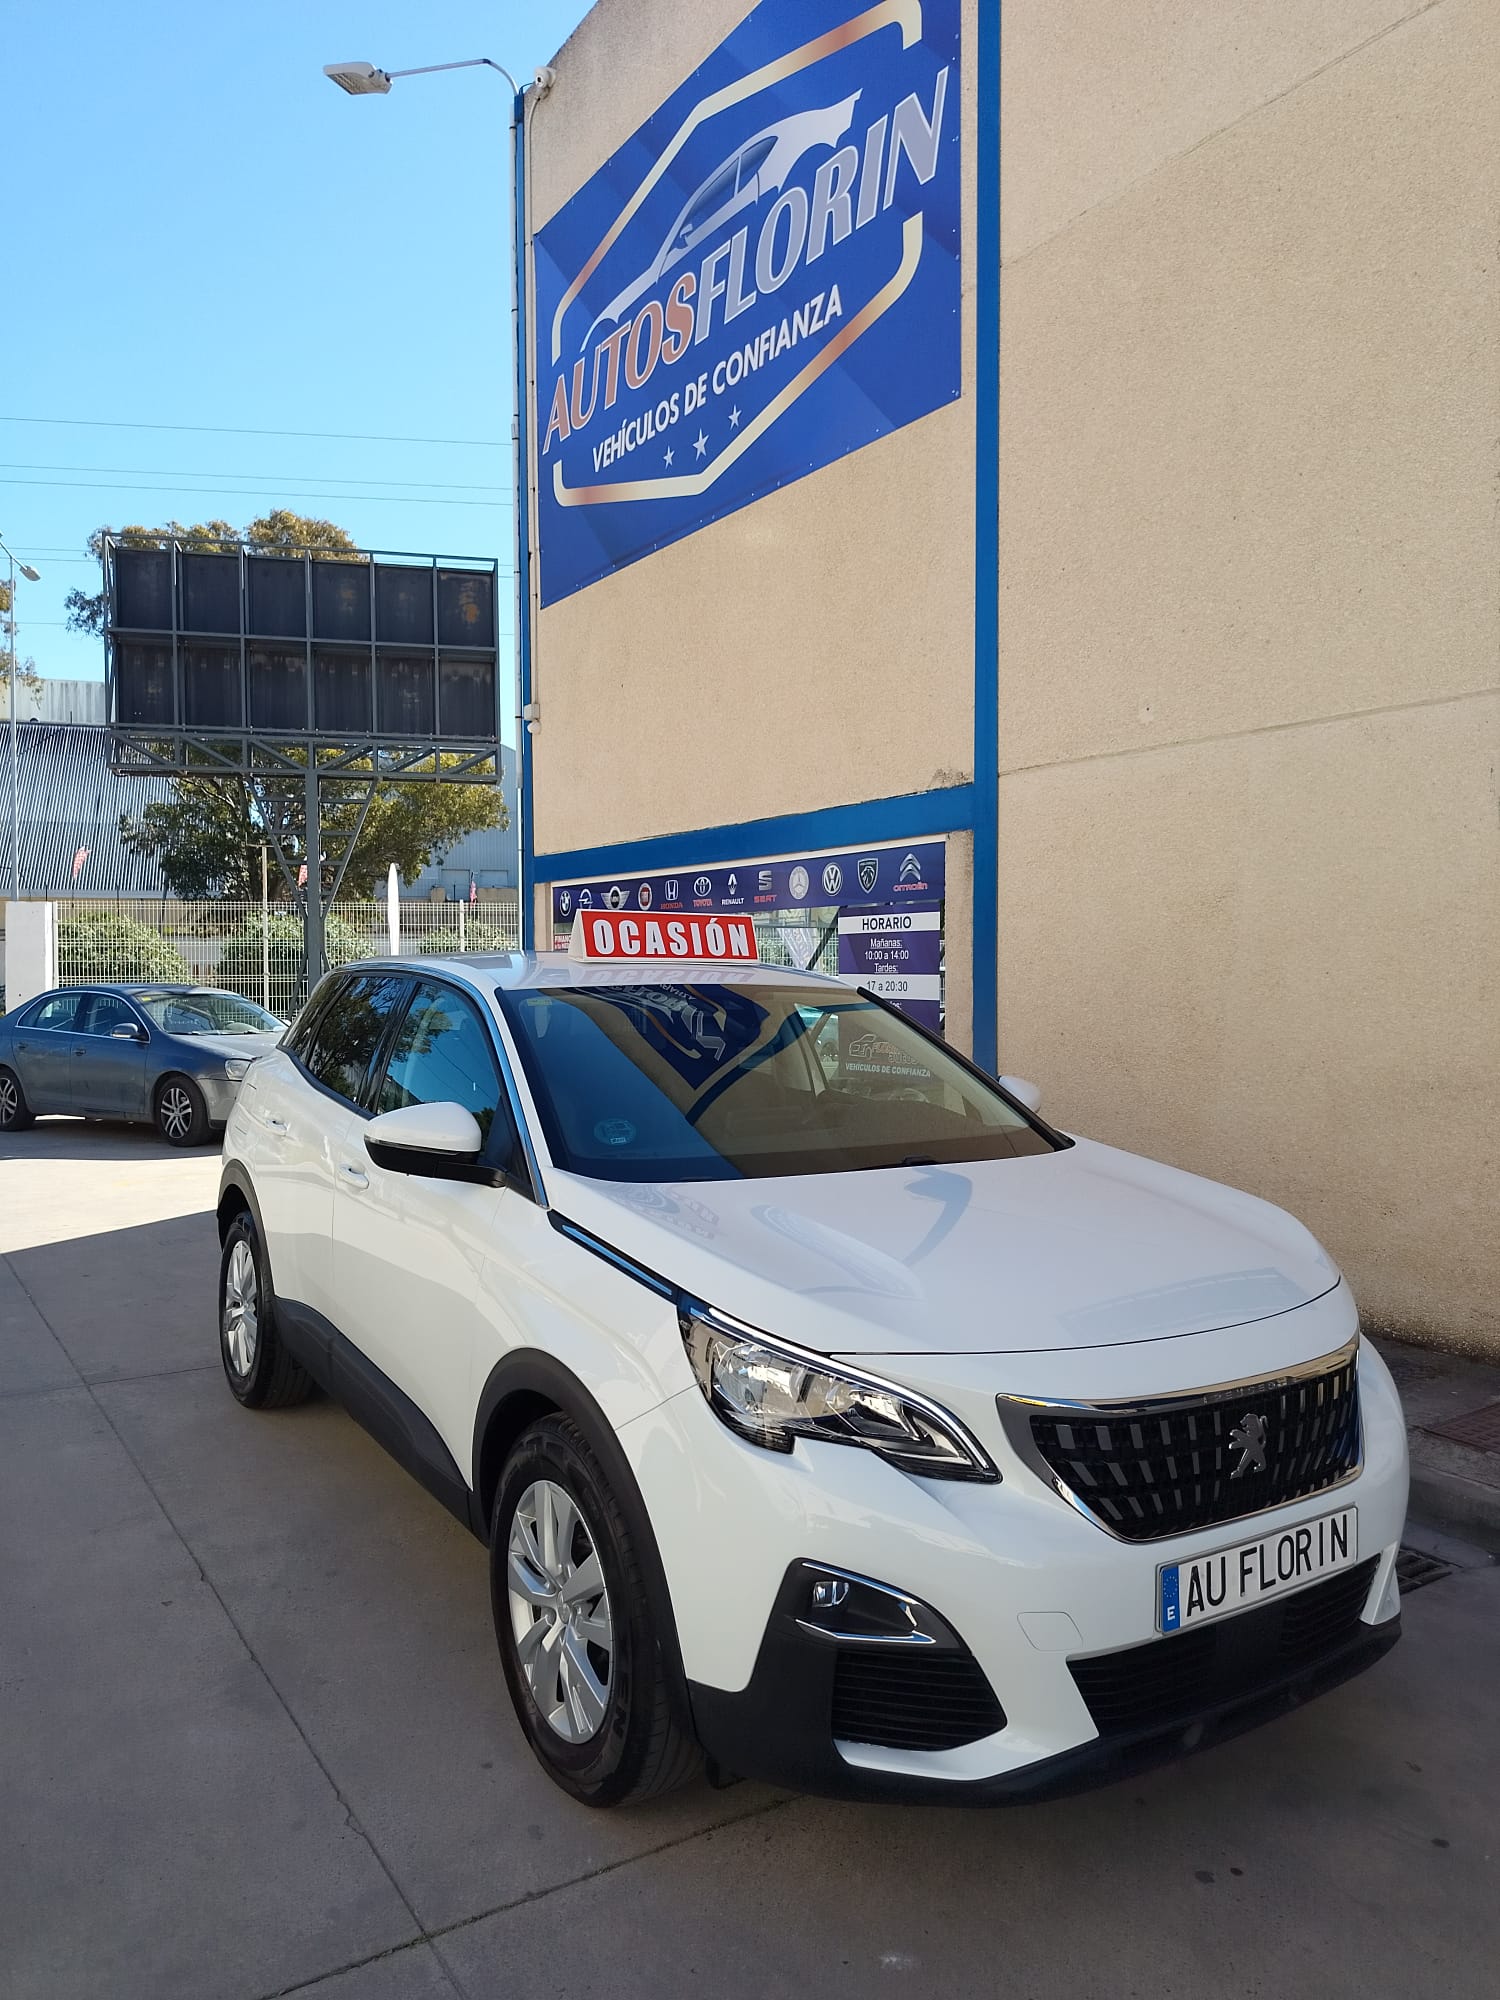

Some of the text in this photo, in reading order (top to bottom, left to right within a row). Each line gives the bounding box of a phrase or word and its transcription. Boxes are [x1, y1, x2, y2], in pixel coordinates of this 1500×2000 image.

[591, 284, 843, 473] VEHÍCULOS DE CONFIANZA
[721, 898, 744, 906] RENAULT
[862, 916, 912, 931] HORARIO
[592, 917, 750, 957] OCASIÓN
[870, 938, 903, 949] Mañanas:
[865, 950, 883, 960] 10:00
[890, 950, 909, 960] 14:00
[874, 963, 898, 973] Tardes:
[867, 981, 876, 991] 17
[885, 981, 908, 992] 20:30
[891, 1066, 931, 1078] CONFIANZA
[1186, 1514, 1348, 1618] AU FLORIN
[1167, 1605, 1176, 1621] E
